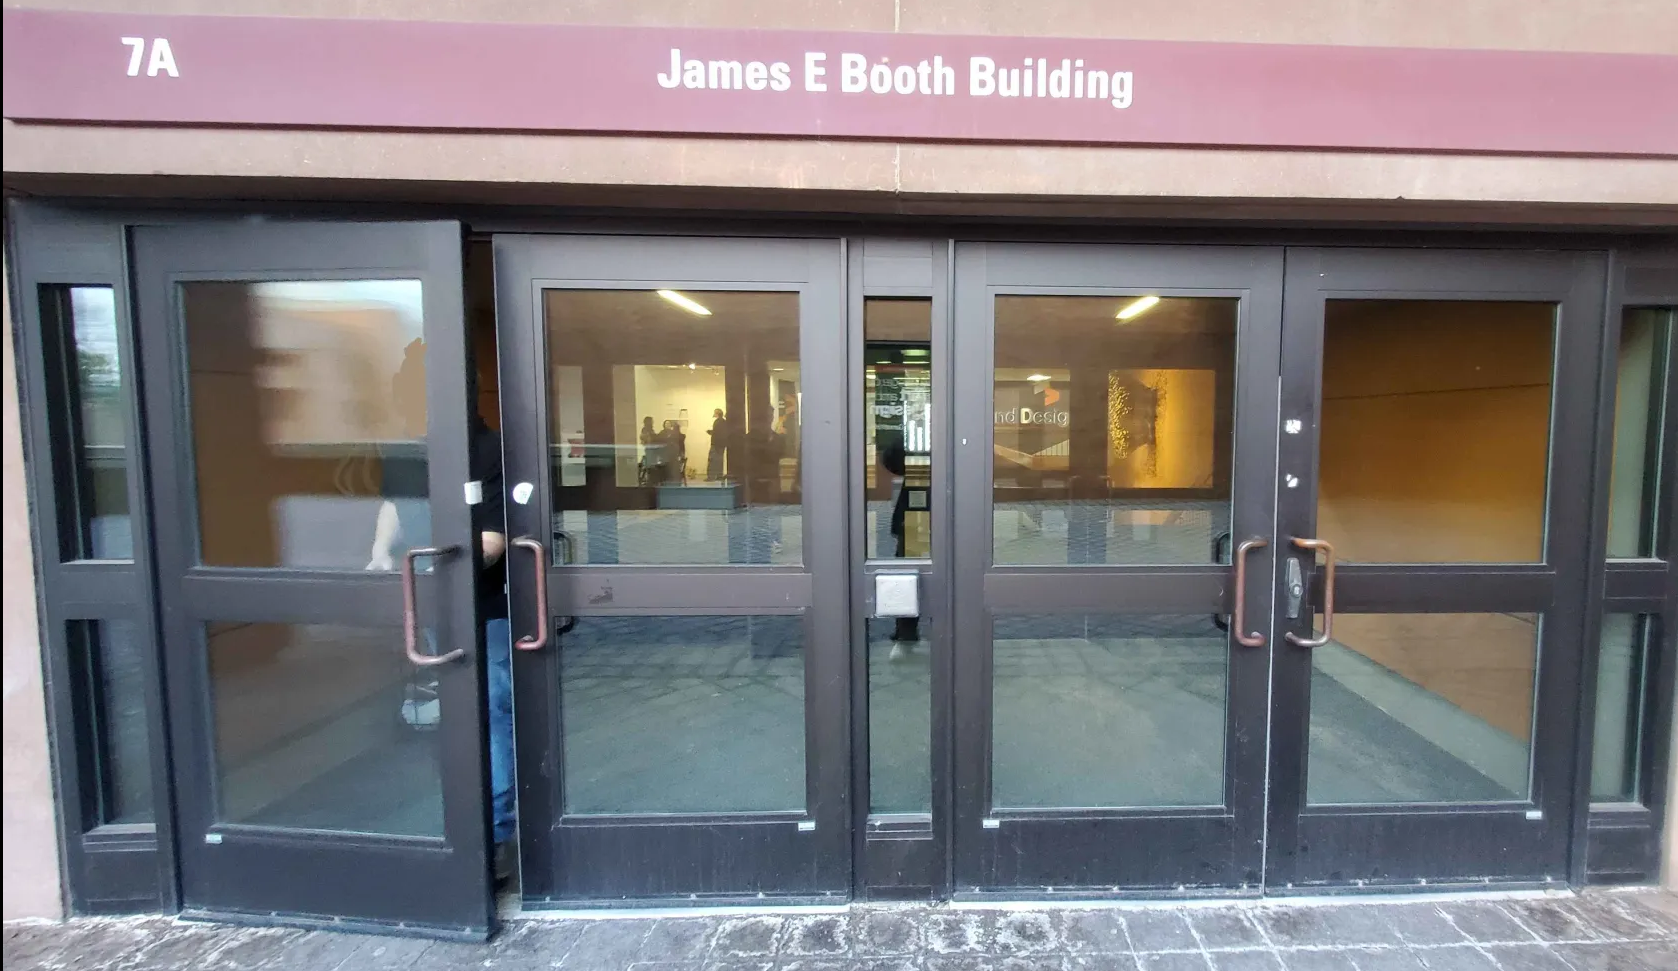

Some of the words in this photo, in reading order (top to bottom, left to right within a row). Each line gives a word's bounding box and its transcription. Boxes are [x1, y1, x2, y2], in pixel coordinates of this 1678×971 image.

[121, 37, 180, 77] 7A
[657, 48, 792, 91] James
[804, 52, 828, 92] E
[841, 53, 956, 96] Booth
[969, 56, 1134, 109] Building
